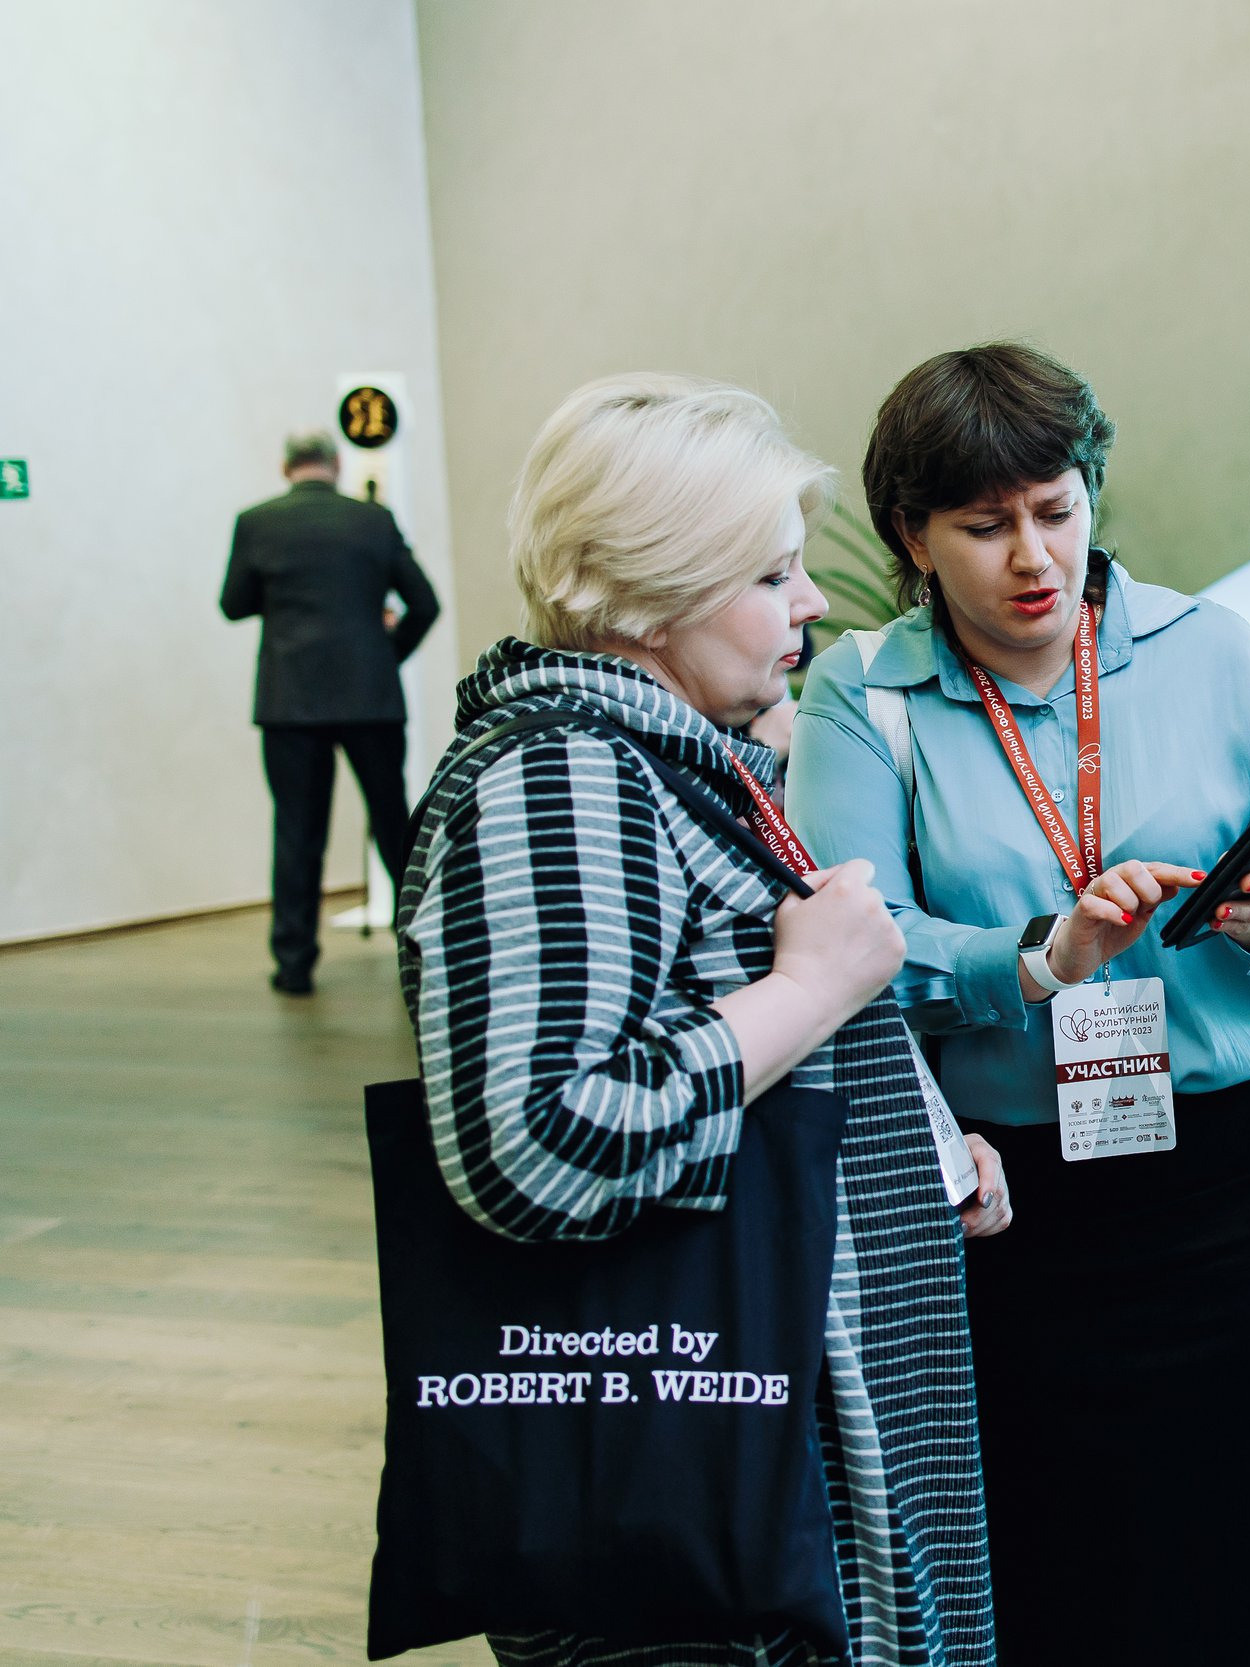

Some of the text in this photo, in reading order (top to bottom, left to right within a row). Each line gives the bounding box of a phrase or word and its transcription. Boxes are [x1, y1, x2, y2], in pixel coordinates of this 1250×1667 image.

[1080, 597, 1093, 720] ТУРНЫЙ ФОРУМ 2023
[983, 687, 1009, 728] ФОРУМ
[1001, 728, 1045, 804] КУЛЬТУРНЫЙ
[734, 758, 813, 875] КУЛЬТУРНЫЙ ФОРУ
[752, 811, 789, 863] КУЛЬТУР
[1035, 801, 1083, 879] БАЛТИЙСКИЙ
[1093, 1001, 1160, 1017] БАЛТИЙСКИЙ
[1094, 1013, 1158, 1028] КУЛЬТУРНЫЙ
[1095, 1026, 1153, 1040] ФОРУМ 2023
[1065, 1056, 1163, 1080] УЧАСТНИК
[499, 1323, 718, 1362] Directed by
[417, 1369, 790, 1408] ROBERT B. WEIDE
